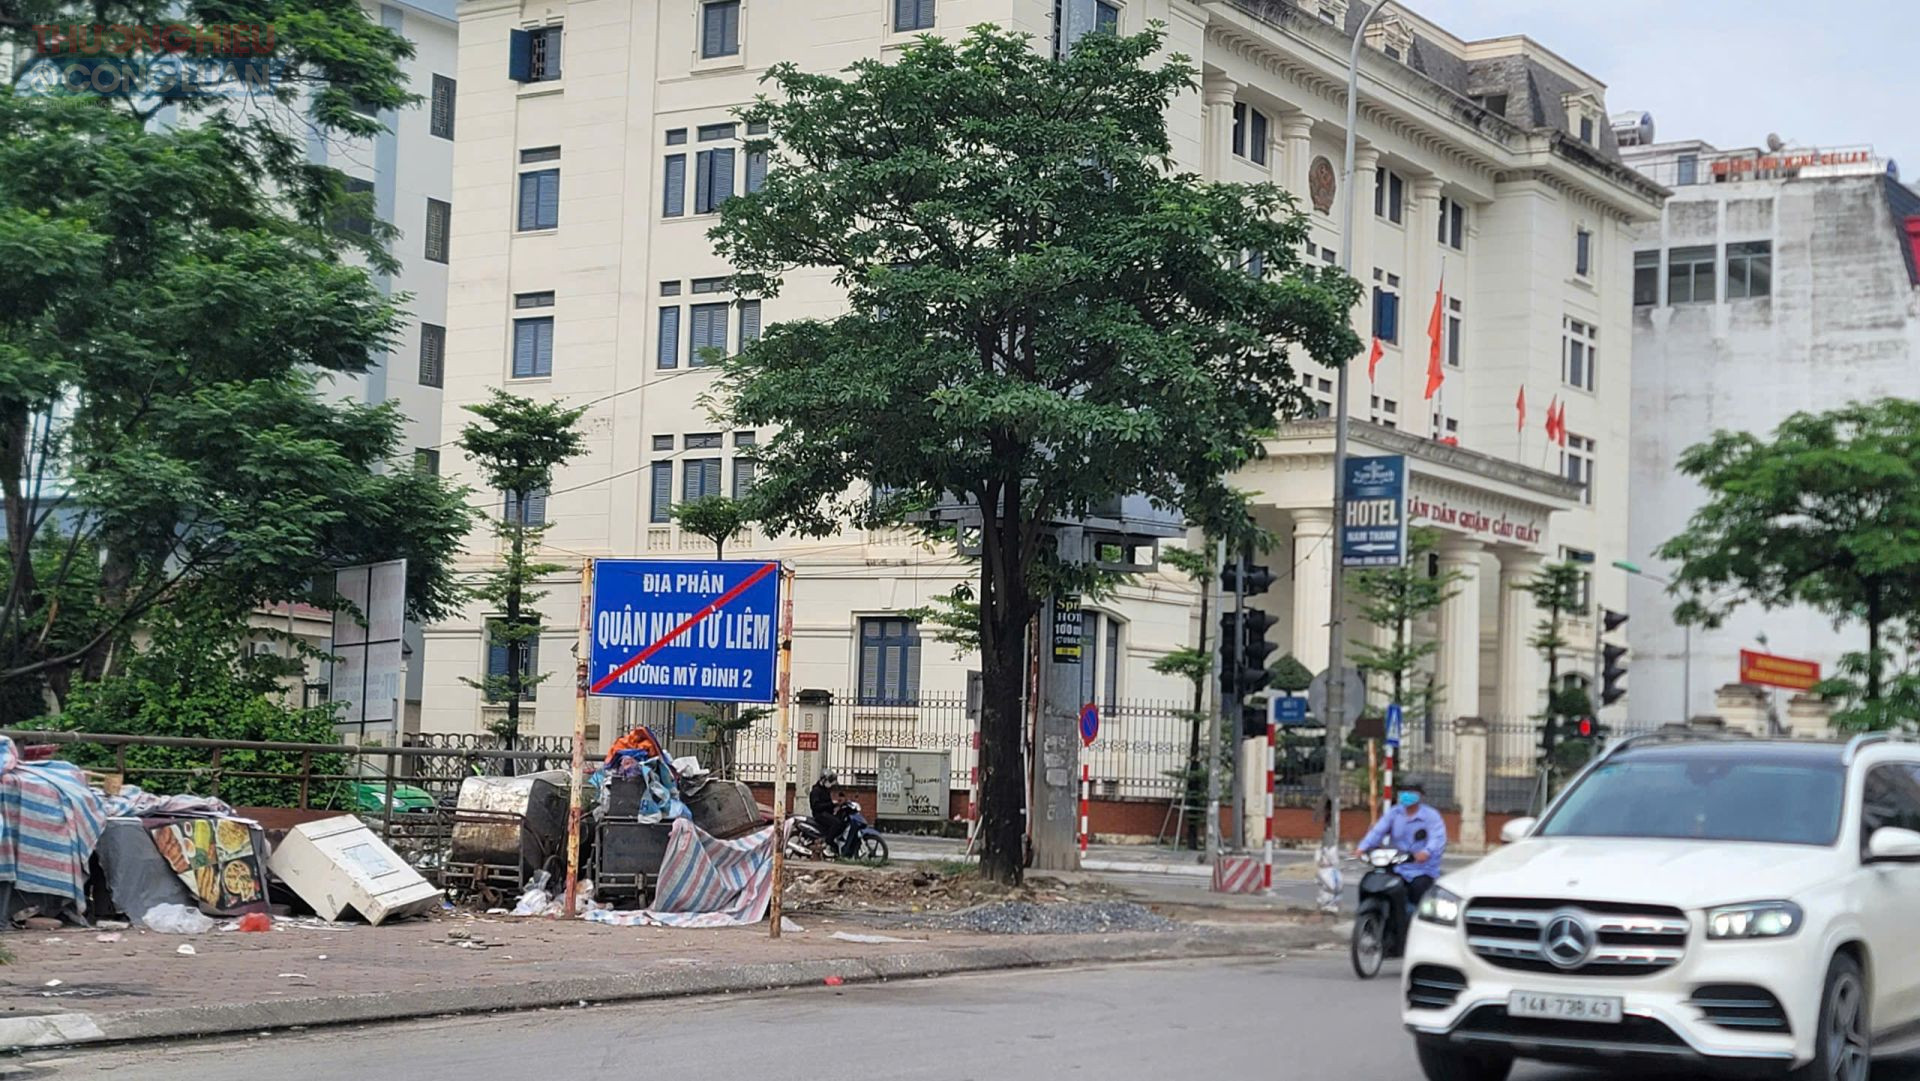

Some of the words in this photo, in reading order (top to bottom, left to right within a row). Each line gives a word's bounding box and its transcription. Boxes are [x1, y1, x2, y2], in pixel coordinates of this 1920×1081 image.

[1345, 500, 1399, 527] HOTEL
[643, 573, 671, 597] ĐỊA
[676, 570, 724, 598] PHẬN
[598, 604, 646, 653] QUẬN
[650, 612, 692, 648] NAM
[725, 606, 770, 650] LIÊM
[673, 663, 698, 686] MỸ
[701, 663, 739, 688] ĐÌNH
[742, 669, 753, 688] 2
